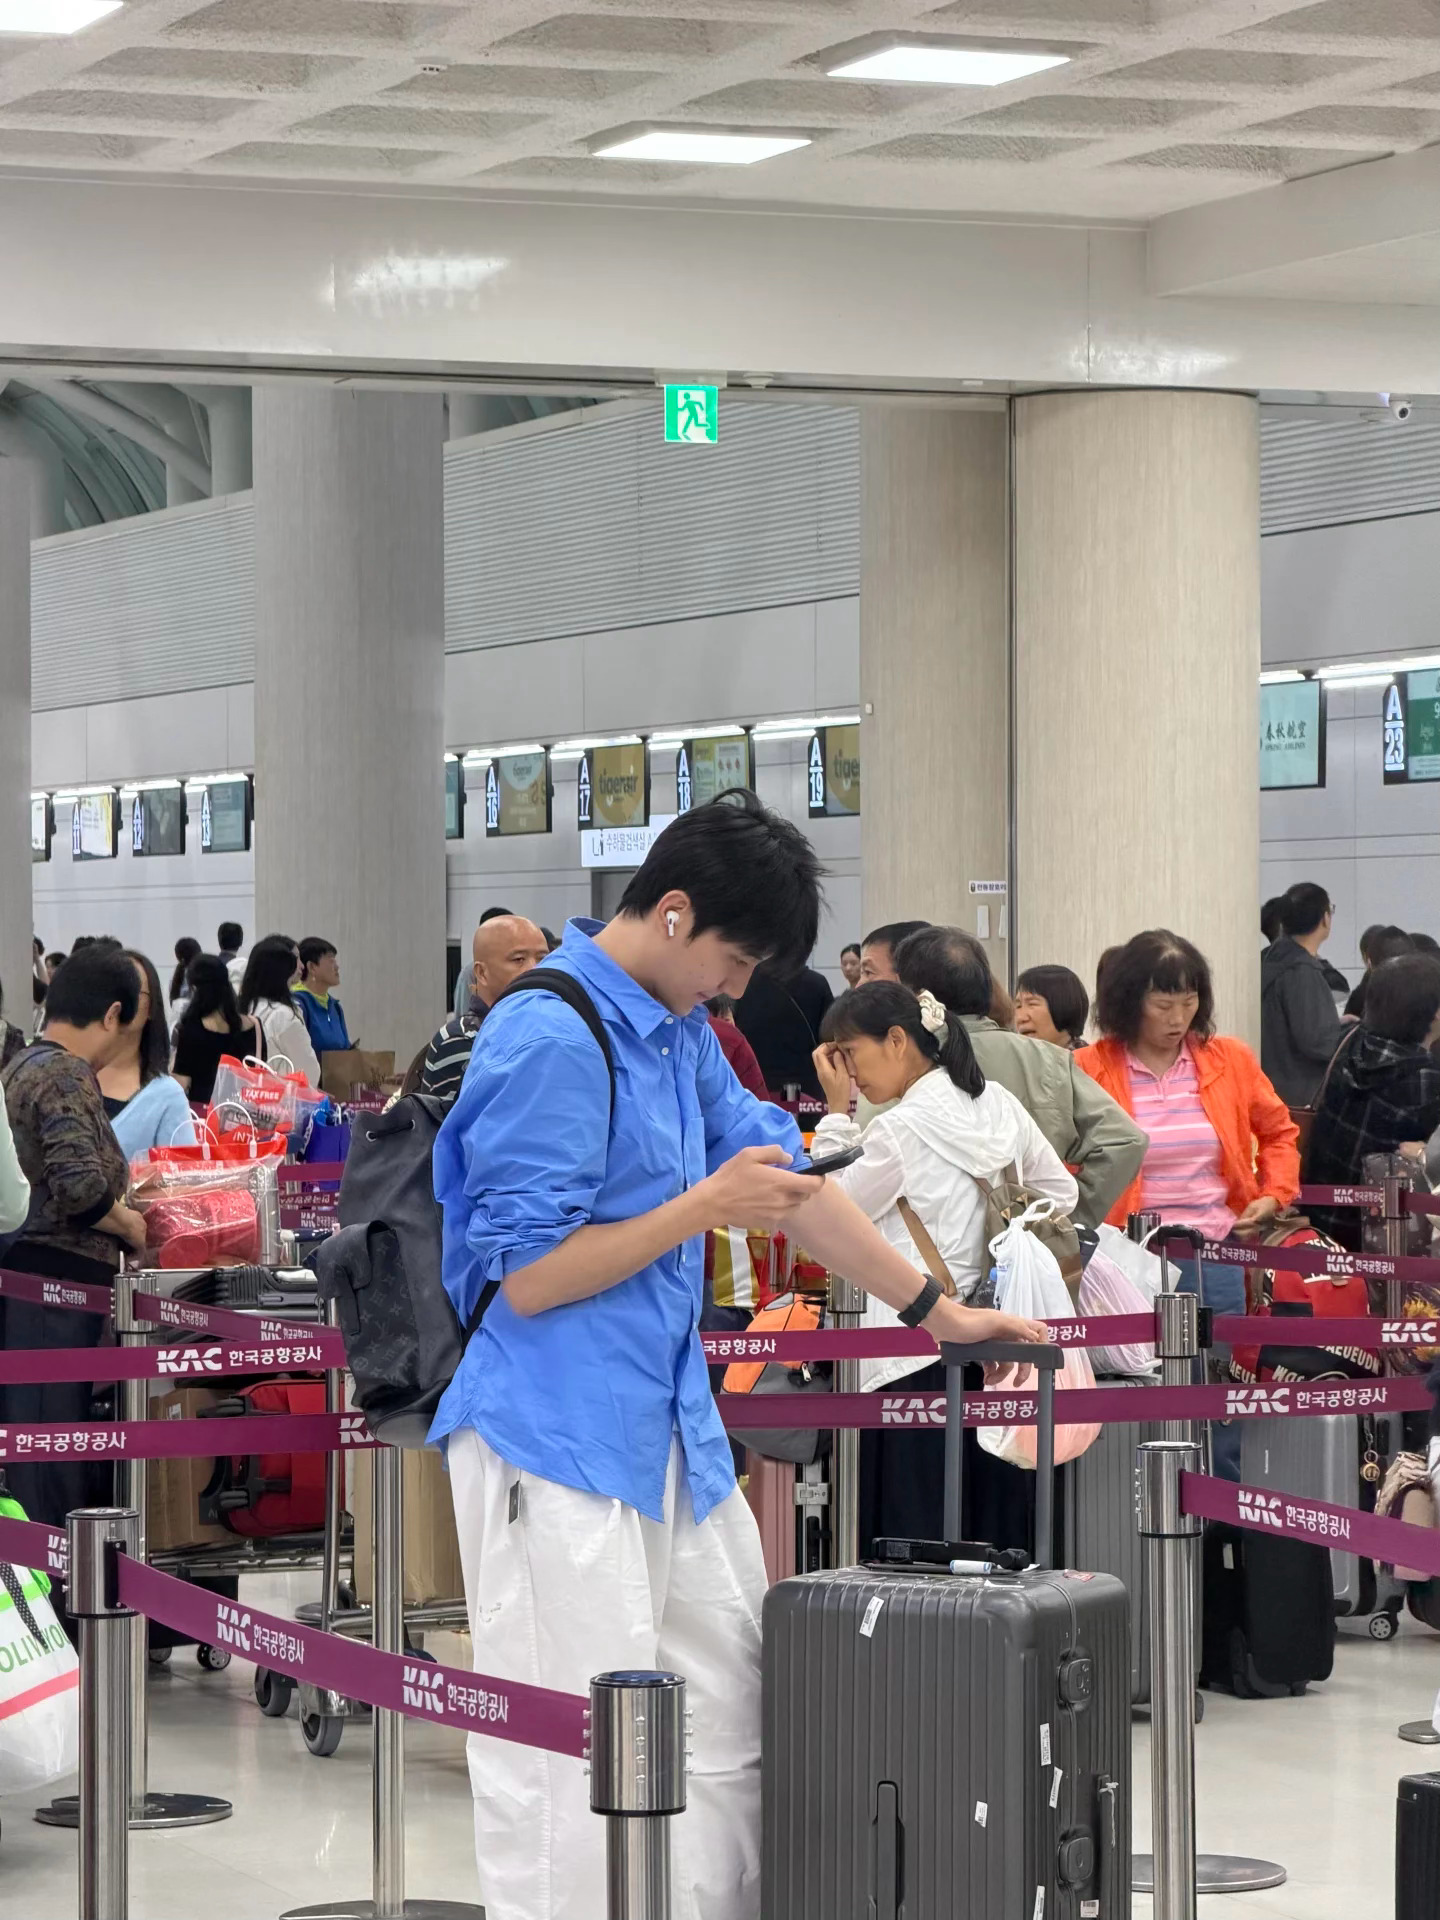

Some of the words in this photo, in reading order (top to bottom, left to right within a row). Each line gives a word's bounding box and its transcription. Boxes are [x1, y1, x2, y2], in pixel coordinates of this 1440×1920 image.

[1386, 685, 1402, 720] A
[810, 737, 822, 766] A
[1385, 728, 1404, 764] 23
[580, 757, 590, 783] A
[679, 749, 689, 776] A
[487, 766, 496, 792] A
[810, 772, 823, 801] 19
[580, 790, 590, 815] 17
[678, 782, 691, 810] 18
[487, 799, 497, 822] 16
[244, 1088, 260, 1100] TAX
[259, 1090, 280, 1101] FREE
[799, 1102, 823, 1113] KAC
[1334, 1188, 1353, 1204] KAC
[1201, 1242, 1220, 1261] AC
[1221, 1247, 1258, 1262] 한국공항공사
[1326, 1254, 1354, 1274] KAC
[1355, 1259, 1396, 1275] 한국공항공사
[43, 1282, 61, 1304] KAC
[160, 1300, 180, 1325] KAC
[180, 1307, 209, 1328] 한국공항공사
[261, 1320, 282, 1342] KAC
[1048, 1324, 1088, 1342] 항공사
[1381, 1321, 1438, 1343] KAC
[156, 1346, 223, 1374] KAC
[228, 1345, 323, 1368] 한국공항공사
[703, 1338, 777, 1356] 국공항공사
[881, 1398, 947, 1424] KAC
[963, 1399, 1039, 1420] 국공항공
[1225, 1387, 1290, 1415] KAC
[1296, 1386, 1388, 1409] 한국공항공사
[15, 1431, 127, 1453] 한국공항공사
[1238, 1489, 1283, 1528] KAC
[1285, 1504, 1351, 1540] 한국공항공사
[216, 1603, 250, 1652] KAC
[253, 1623, 305, 1665] 한국공항공사
[402, 1665, 444, 1714] KAC
[447, 1682, 509, 1723] 한국공항공사
